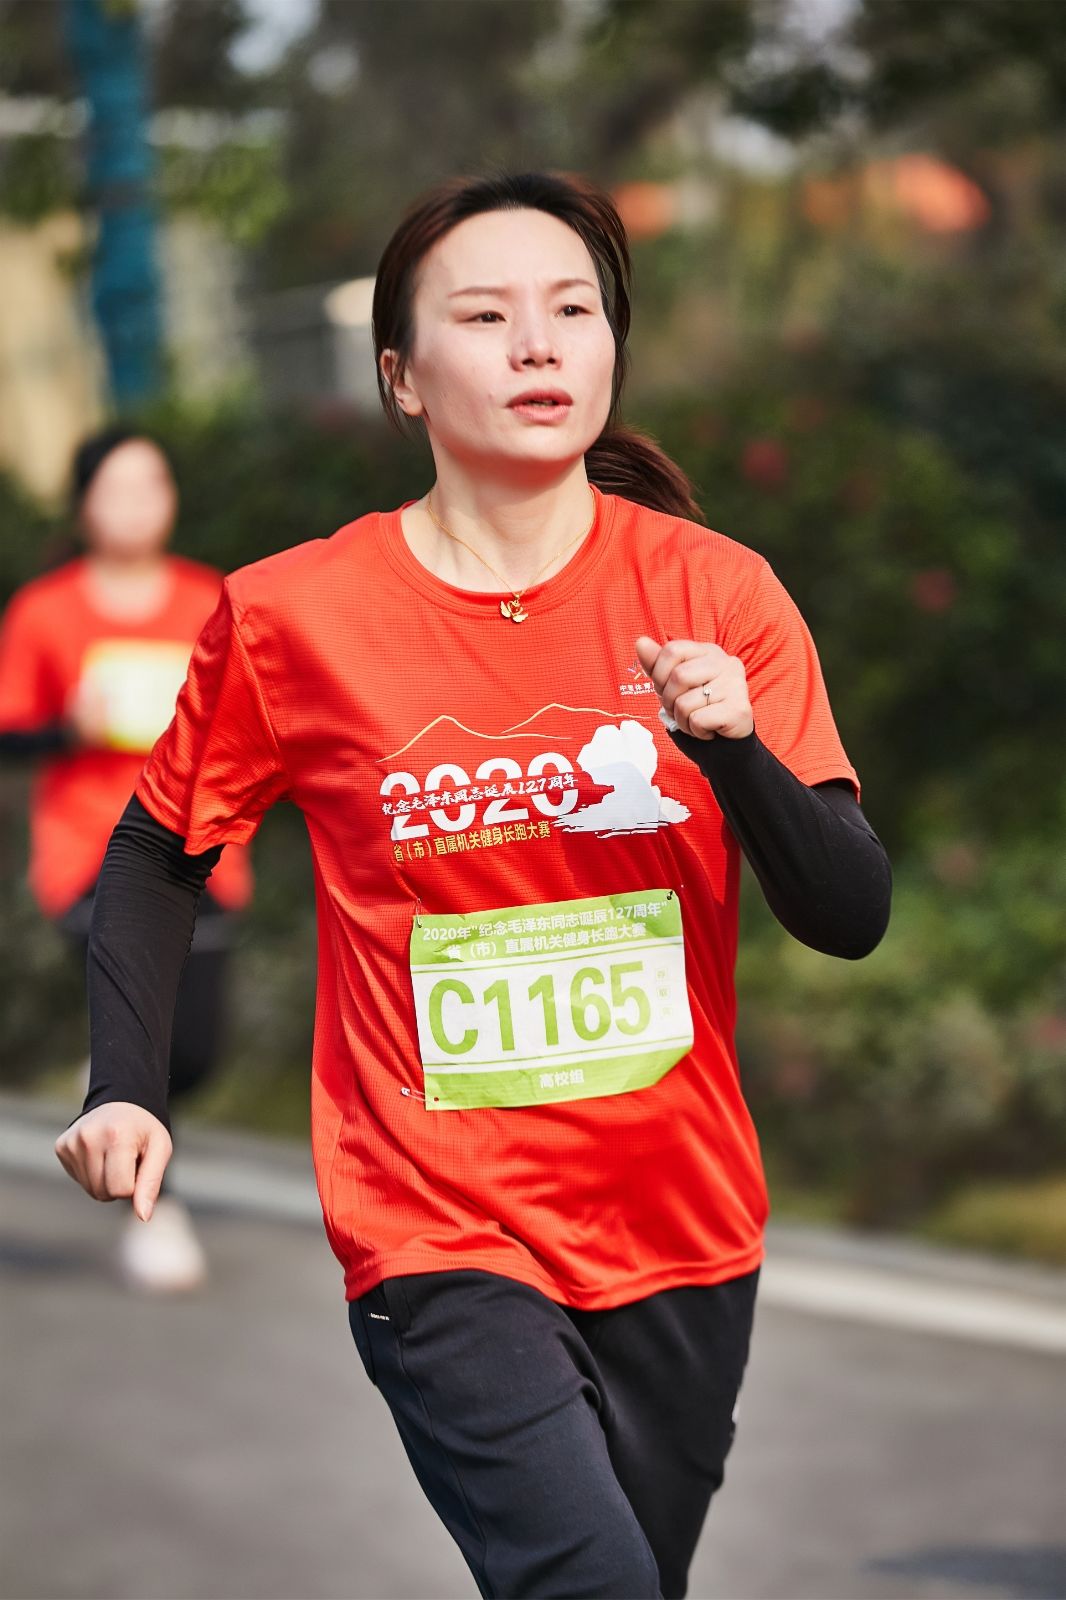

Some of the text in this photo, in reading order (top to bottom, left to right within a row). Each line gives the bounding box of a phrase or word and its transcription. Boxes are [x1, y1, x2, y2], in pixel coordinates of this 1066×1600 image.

[428, 961, 650, 1055] C1165
[538, 1068, 585, 1088] 高校组
